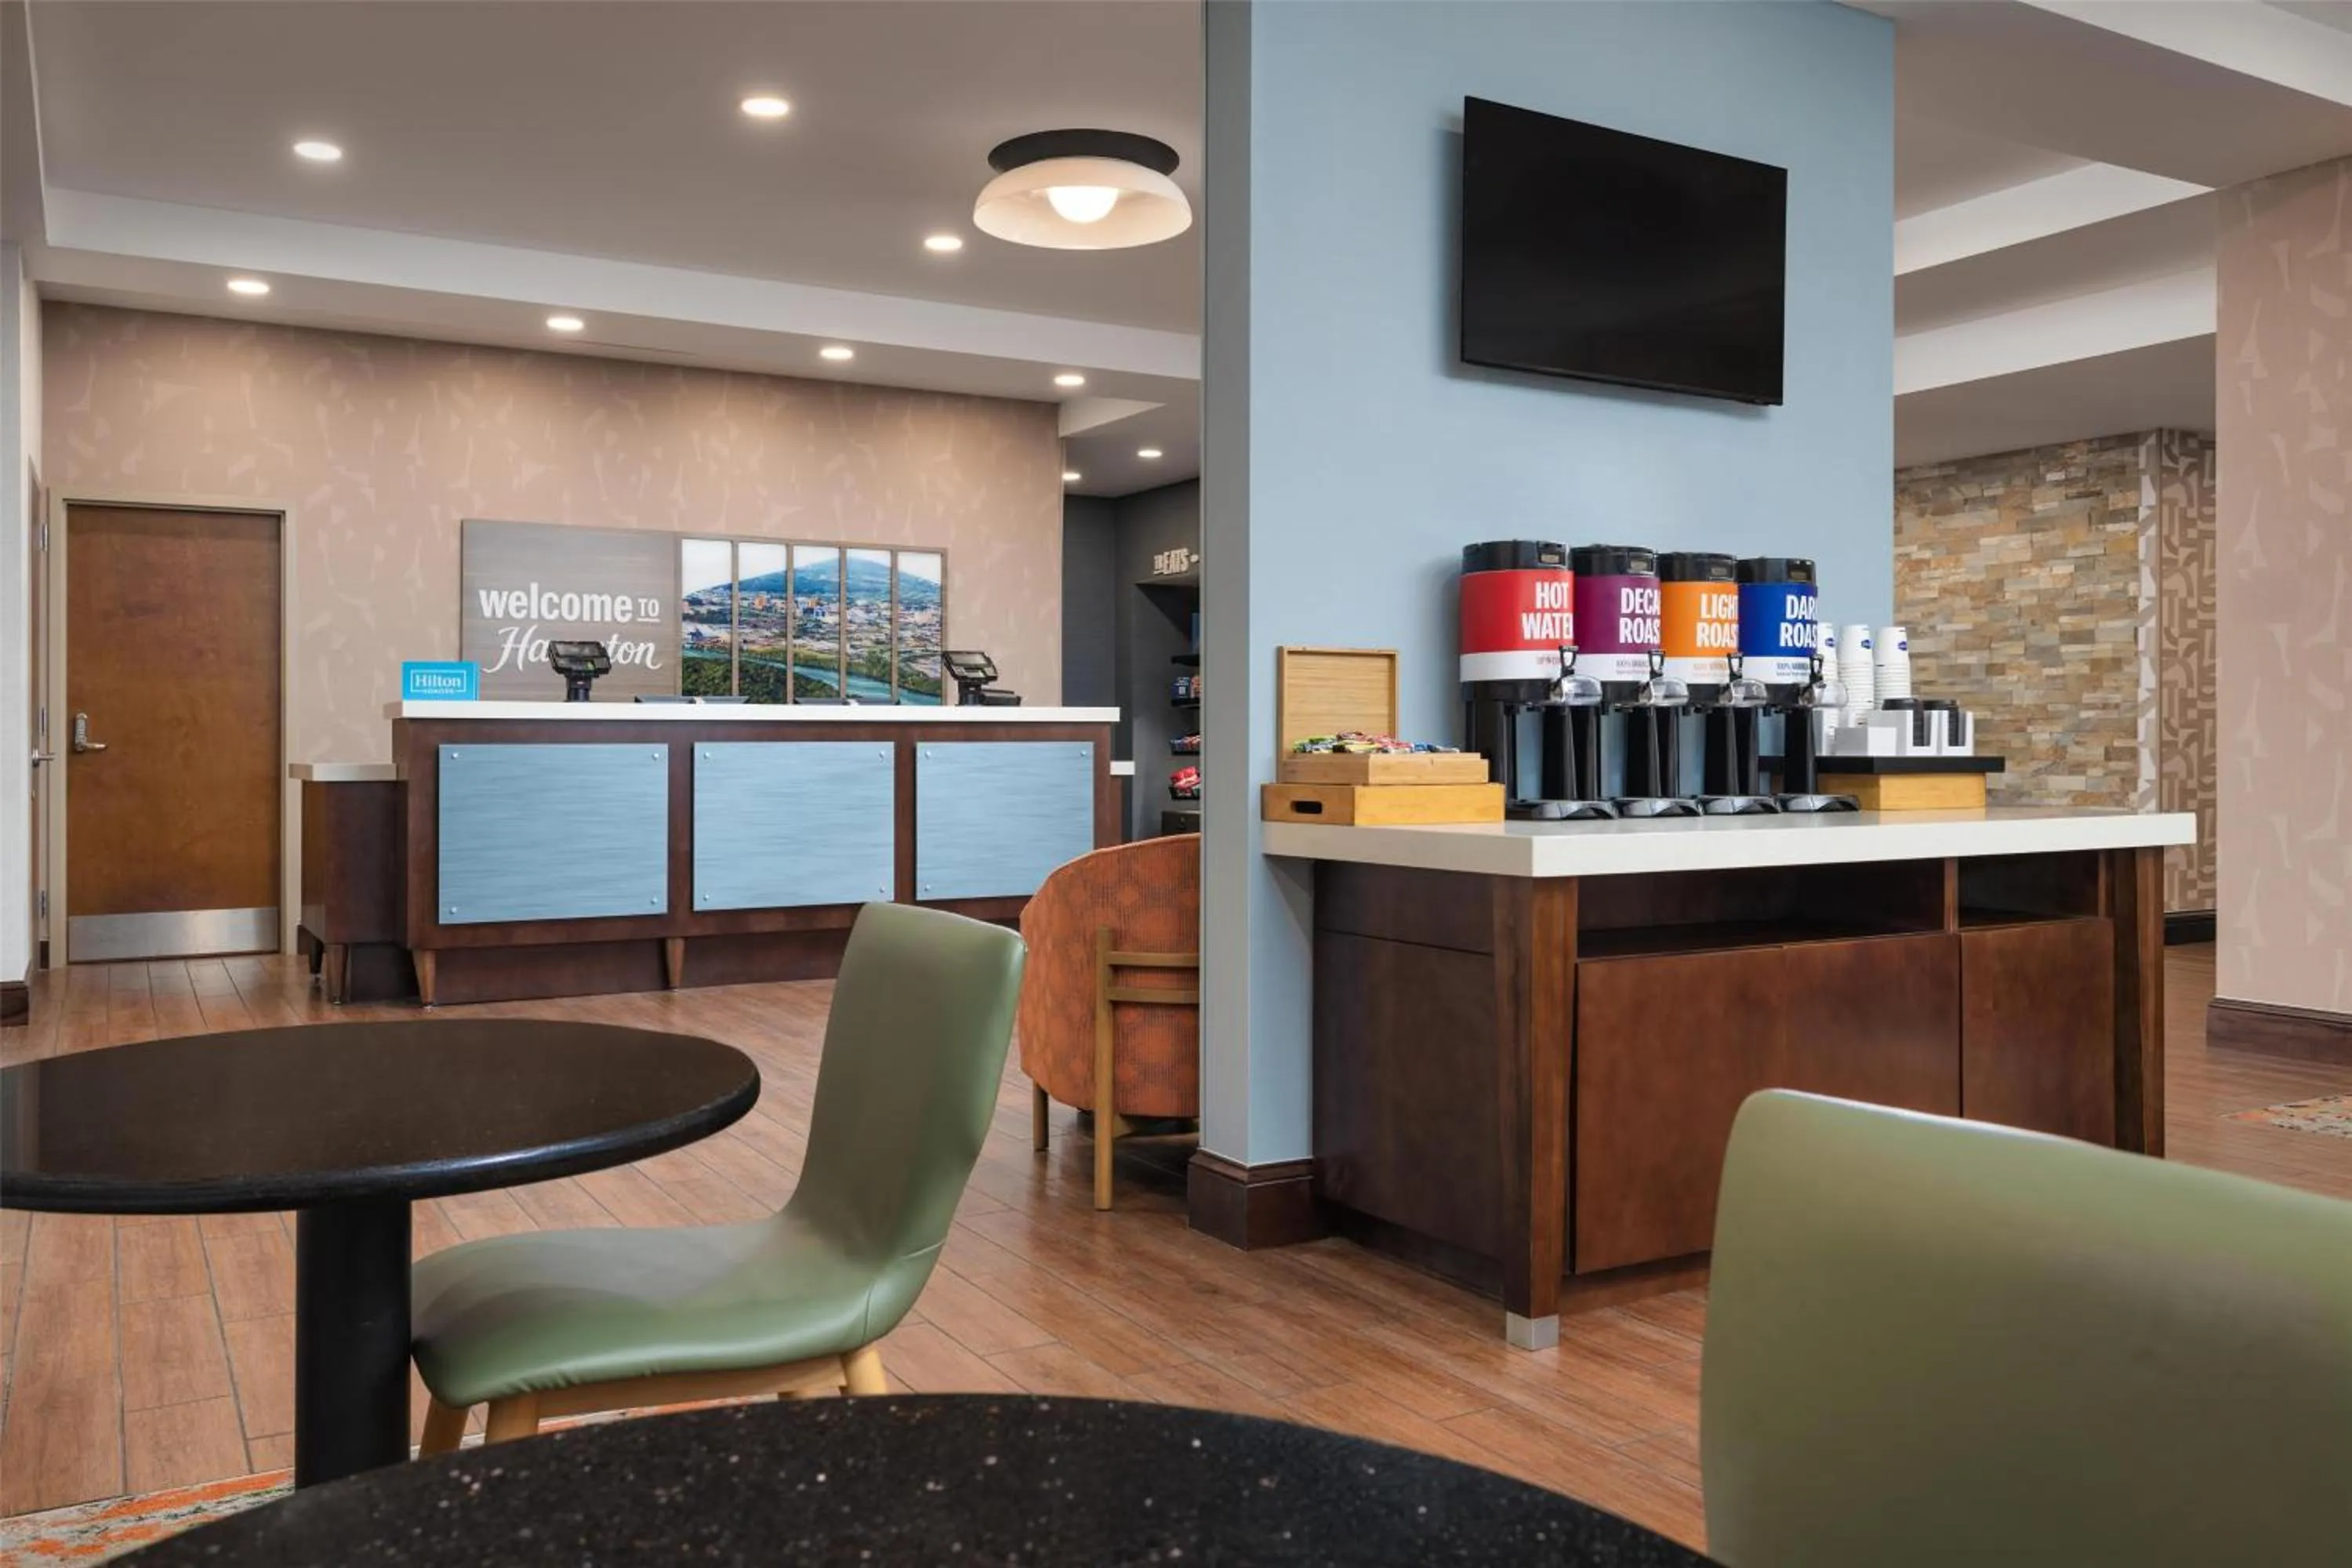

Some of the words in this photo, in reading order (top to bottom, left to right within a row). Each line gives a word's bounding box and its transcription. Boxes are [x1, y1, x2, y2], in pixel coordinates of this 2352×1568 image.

[478, 582, 633, 622] welcome
[636, 598, 660, 617] TO
[1535, 581, 1569, 609] HOT
[1621, 587, 1661, 615] DECA
[1785, 594, 1817, 621] DAR
[1522, 612, 1573, 640] WATE
[1619, 617, 1661, 645] ROAS
[1696, 622, 1739, 648] ROAS
[1779, 622, 1817, 648] ROAS
[481, 625, 662, 673] Haton
[415, 674, 461, 688] Hilton
